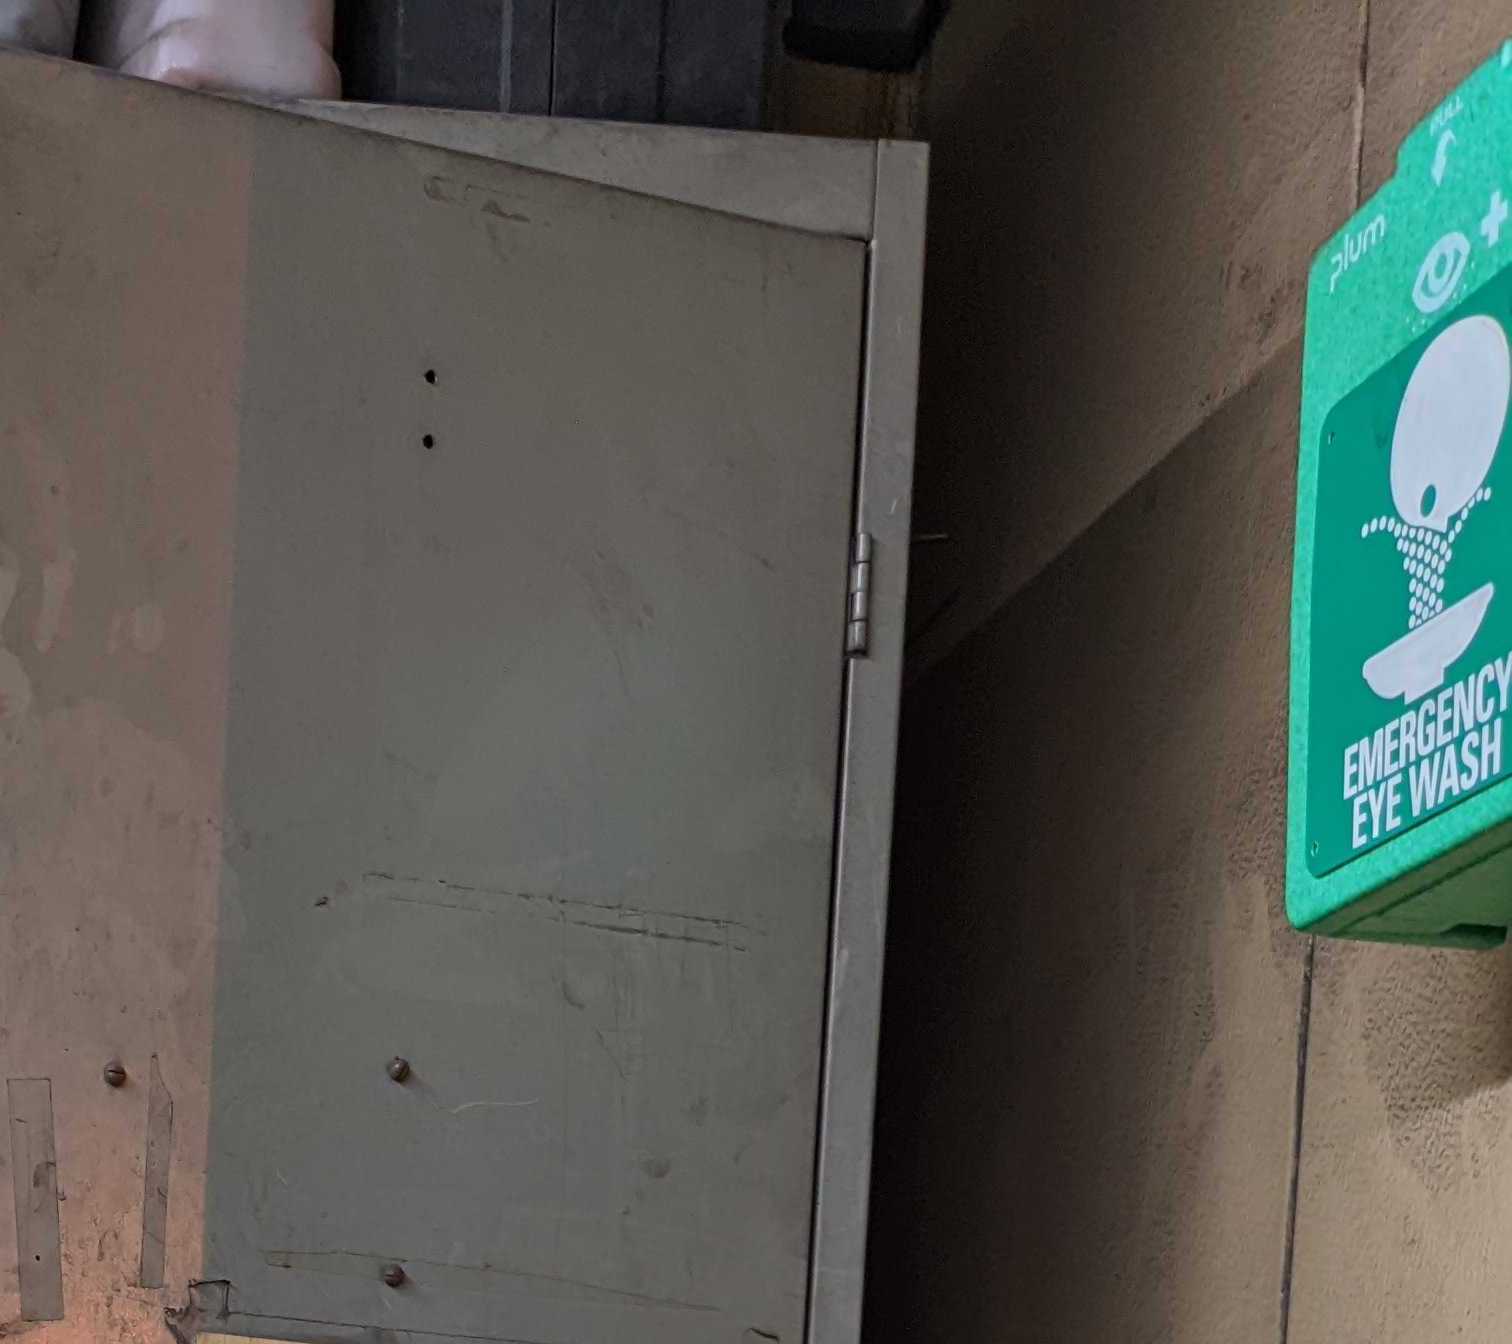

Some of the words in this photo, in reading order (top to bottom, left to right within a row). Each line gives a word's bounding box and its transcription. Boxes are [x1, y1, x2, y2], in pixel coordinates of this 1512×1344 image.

[1331, 214, 1385, 293] plum
[1343, 650, 1512, 800] EMERGENCY
[1352, 772, 1402, 849] EYE
[1409, 717, 1502, 817] WASH
